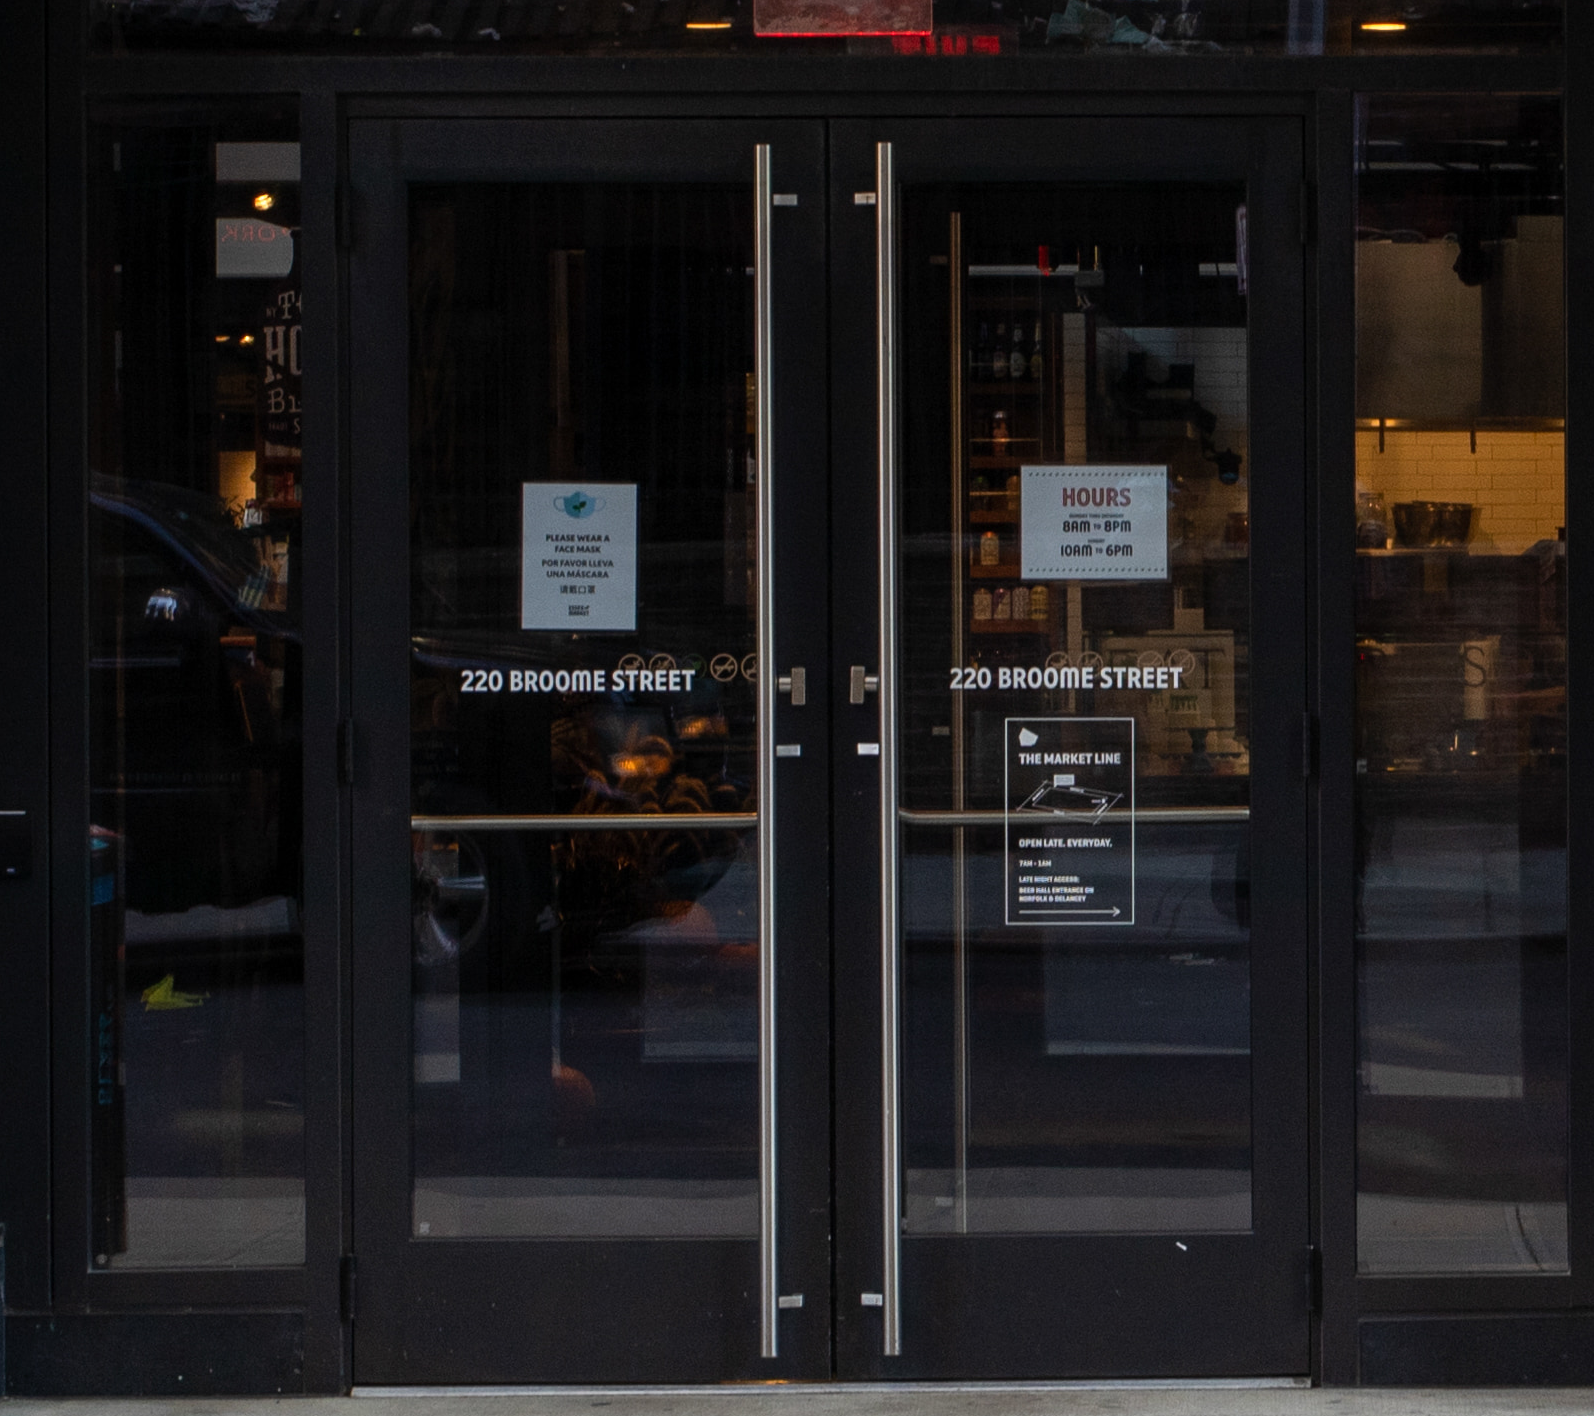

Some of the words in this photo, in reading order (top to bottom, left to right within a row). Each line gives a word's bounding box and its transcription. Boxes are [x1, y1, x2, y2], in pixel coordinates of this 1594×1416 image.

[1062, 487, 1131, 507] HOURS
[1063, 520, 1091, 533] 8AM
[1104, 520, 1132, 533] 8PM
[545, 534, 575, 543] PLEASE
[576, 534, 602, 543] WEAR
[603, 534, 610, 542] A
[554, 545, 574, 554] FACE
[575, 545, 601, 554] MASK
[1060, 544, 1093, 557] 10AM
[1106, 544, 1133, 557] 6PM
[541, 559, 558, 568] POR
[559, 559, 587, 568] FAVOR
[588, 559, 614, 568] LLEVA
[546, 570, 566, 579] UNA
[460, 670, 504, 692] 220
[510, 670, 606, 692] BROOME
[612, 669, 696, 692] STREET
[949, 667, 992, 690] 220
[998, 666, 1094, 689] BROOME
[1100, 666, 1183, 689] STREET
[1019, 753, 1043, 765] THE
[1044, 753, 1093, 765] MARKET
[1094, 753, 1122, 765] LINE
[1019, 838, 1043, 848] OPEN
